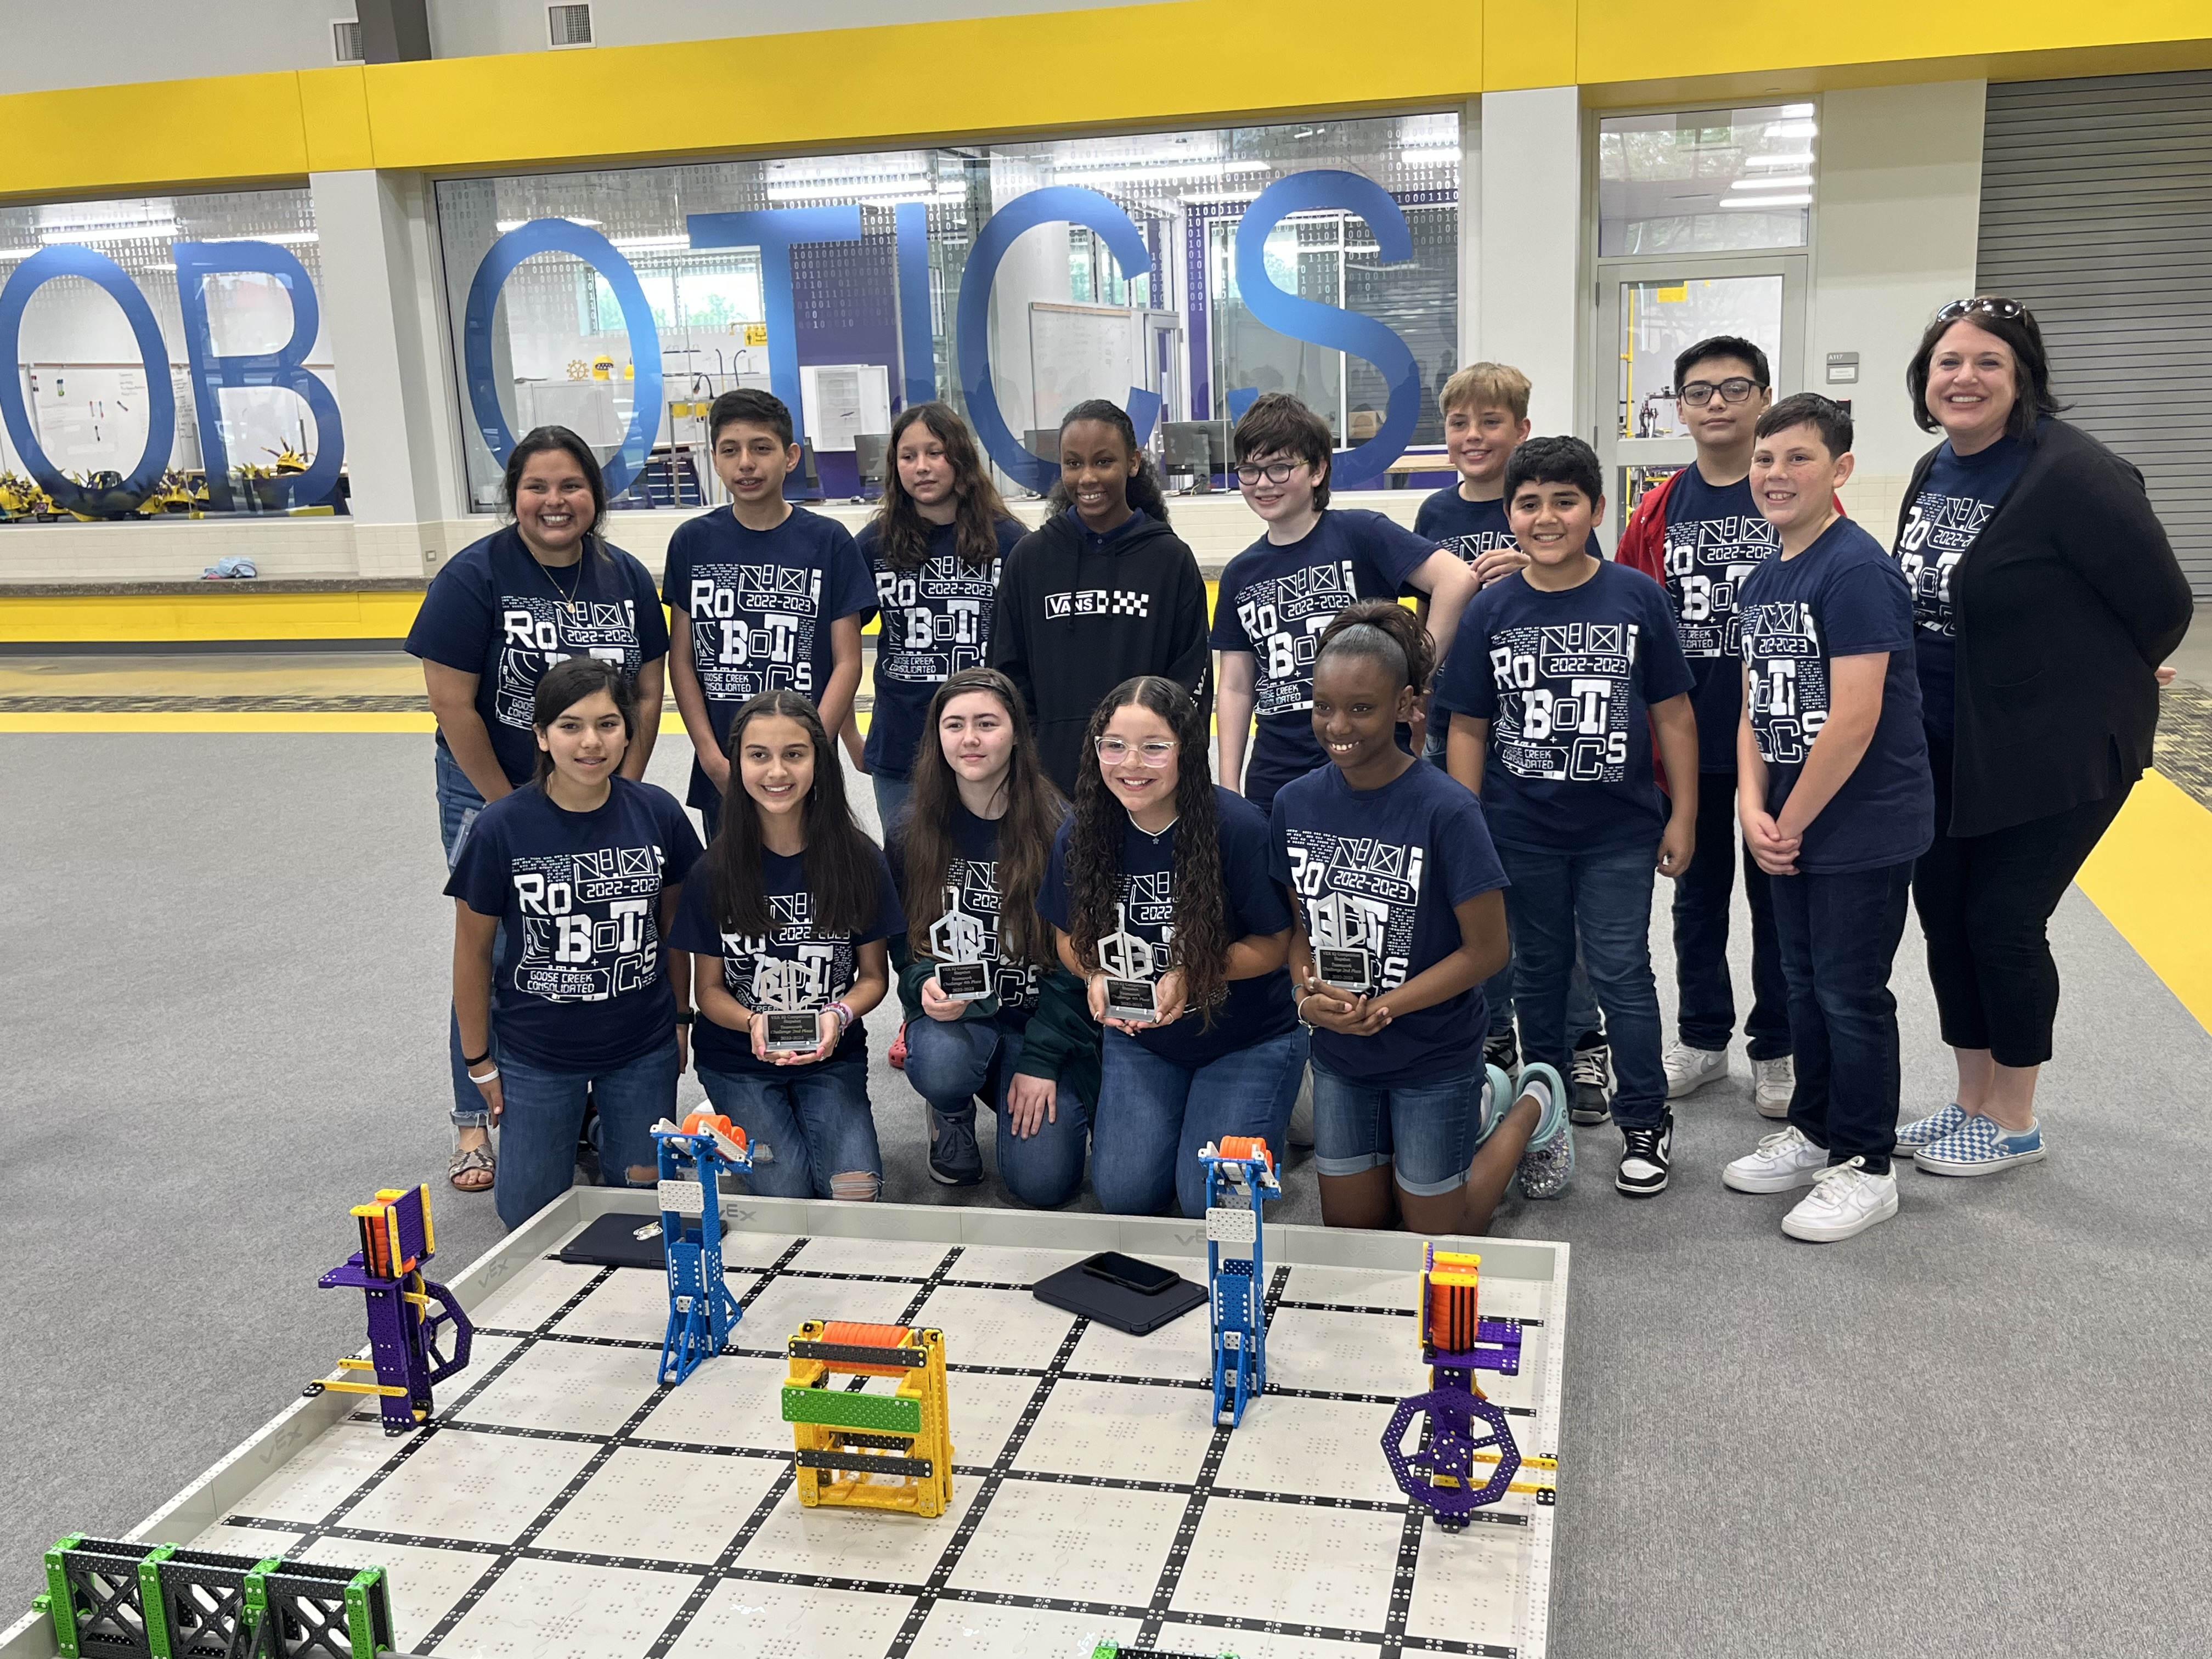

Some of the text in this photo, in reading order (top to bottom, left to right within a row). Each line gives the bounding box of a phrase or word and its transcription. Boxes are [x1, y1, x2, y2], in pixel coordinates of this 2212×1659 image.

[1707, 545, 1778, 561] 2022-202
[928, 583, 993, 596] 2022-2023
[746, 594, 811, 612] 2022-2023
[1049, 593, 1093, 614] VANS
[1288, 595, 1350, 617] 2022-2023
[567, 629, 634, 642] 2022-2023
[911, 657, 934, 665] CREEK
[1550, 657, 1627, 674] 2022-2023
[726, 674, 749, 682] CREEK
[1276, 684, 1299, 696] CREEK
[1525, 748, 1551, 759] CREEK
[586, 877, 659, 898] 2022-2023
[1333, 870, 1409, 900] 2022-2023
[530, 970, 592, 983] GOOSE CREEK
[527, 980, 595, 994] CONSOLIDATED
